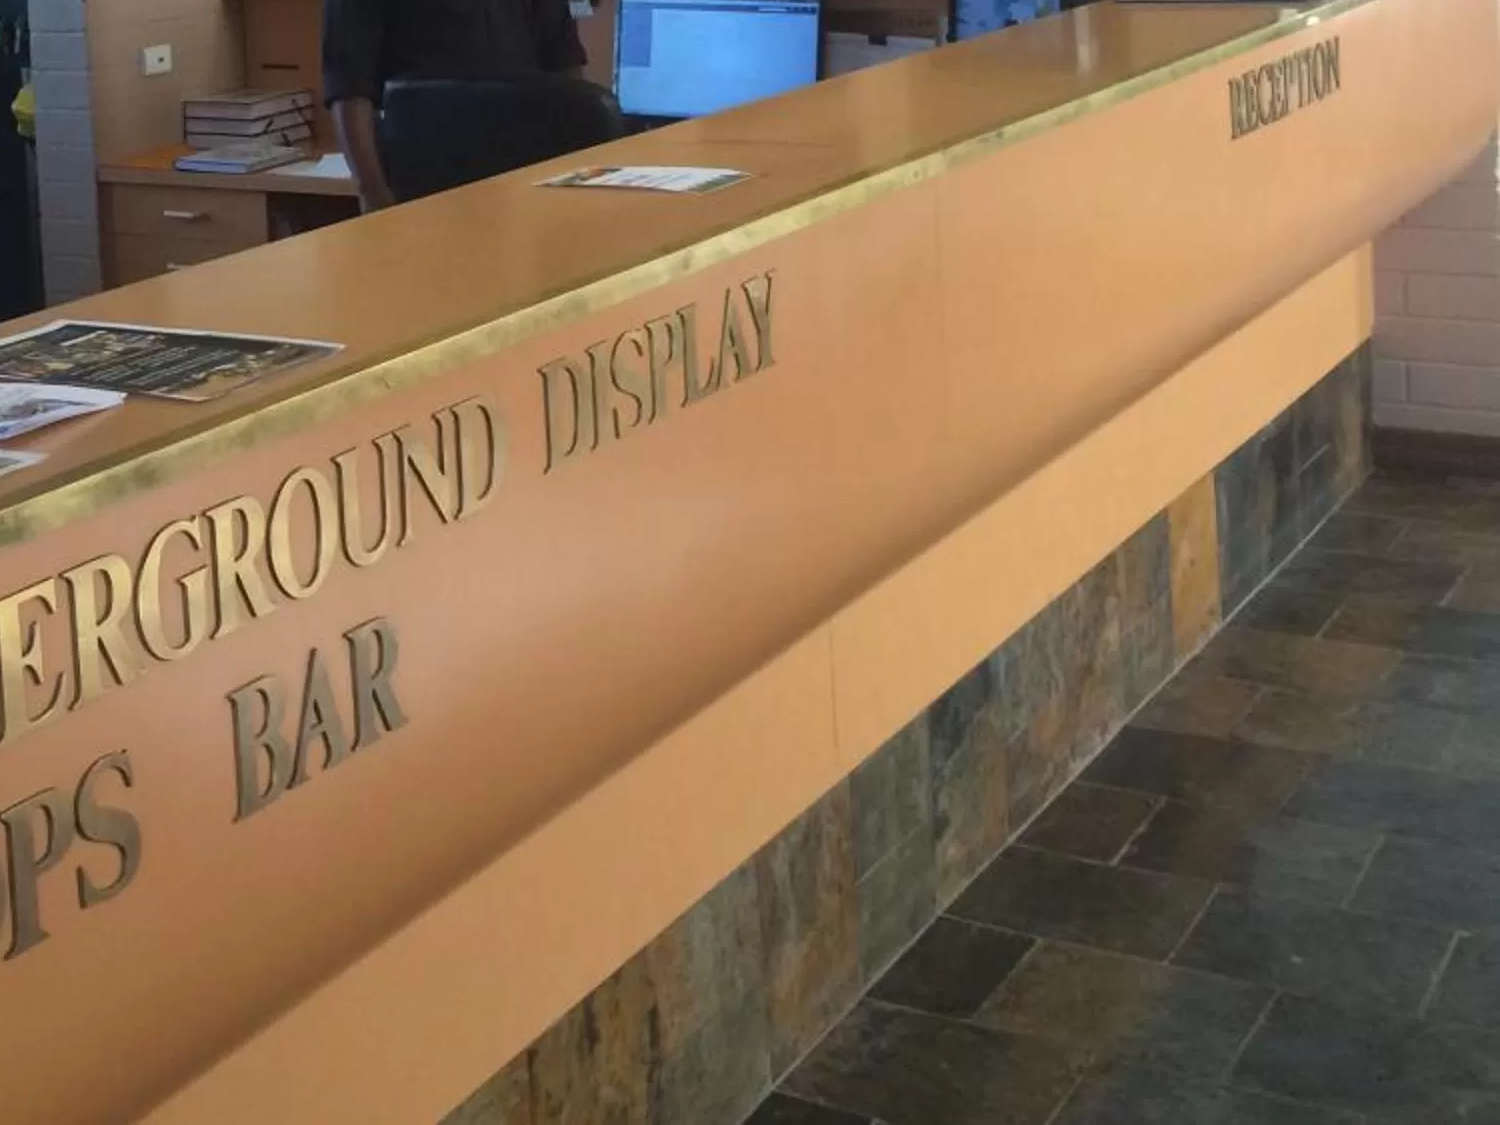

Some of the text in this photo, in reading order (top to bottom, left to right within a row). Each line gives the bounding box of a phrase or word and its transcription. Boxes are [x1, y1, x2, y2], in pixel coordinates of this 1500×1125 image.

[1227, 36, 1341, 140] RECEPTION
[536, 268, 777, 475] DISPLAY
[226, 616, 411, 824] BAR
